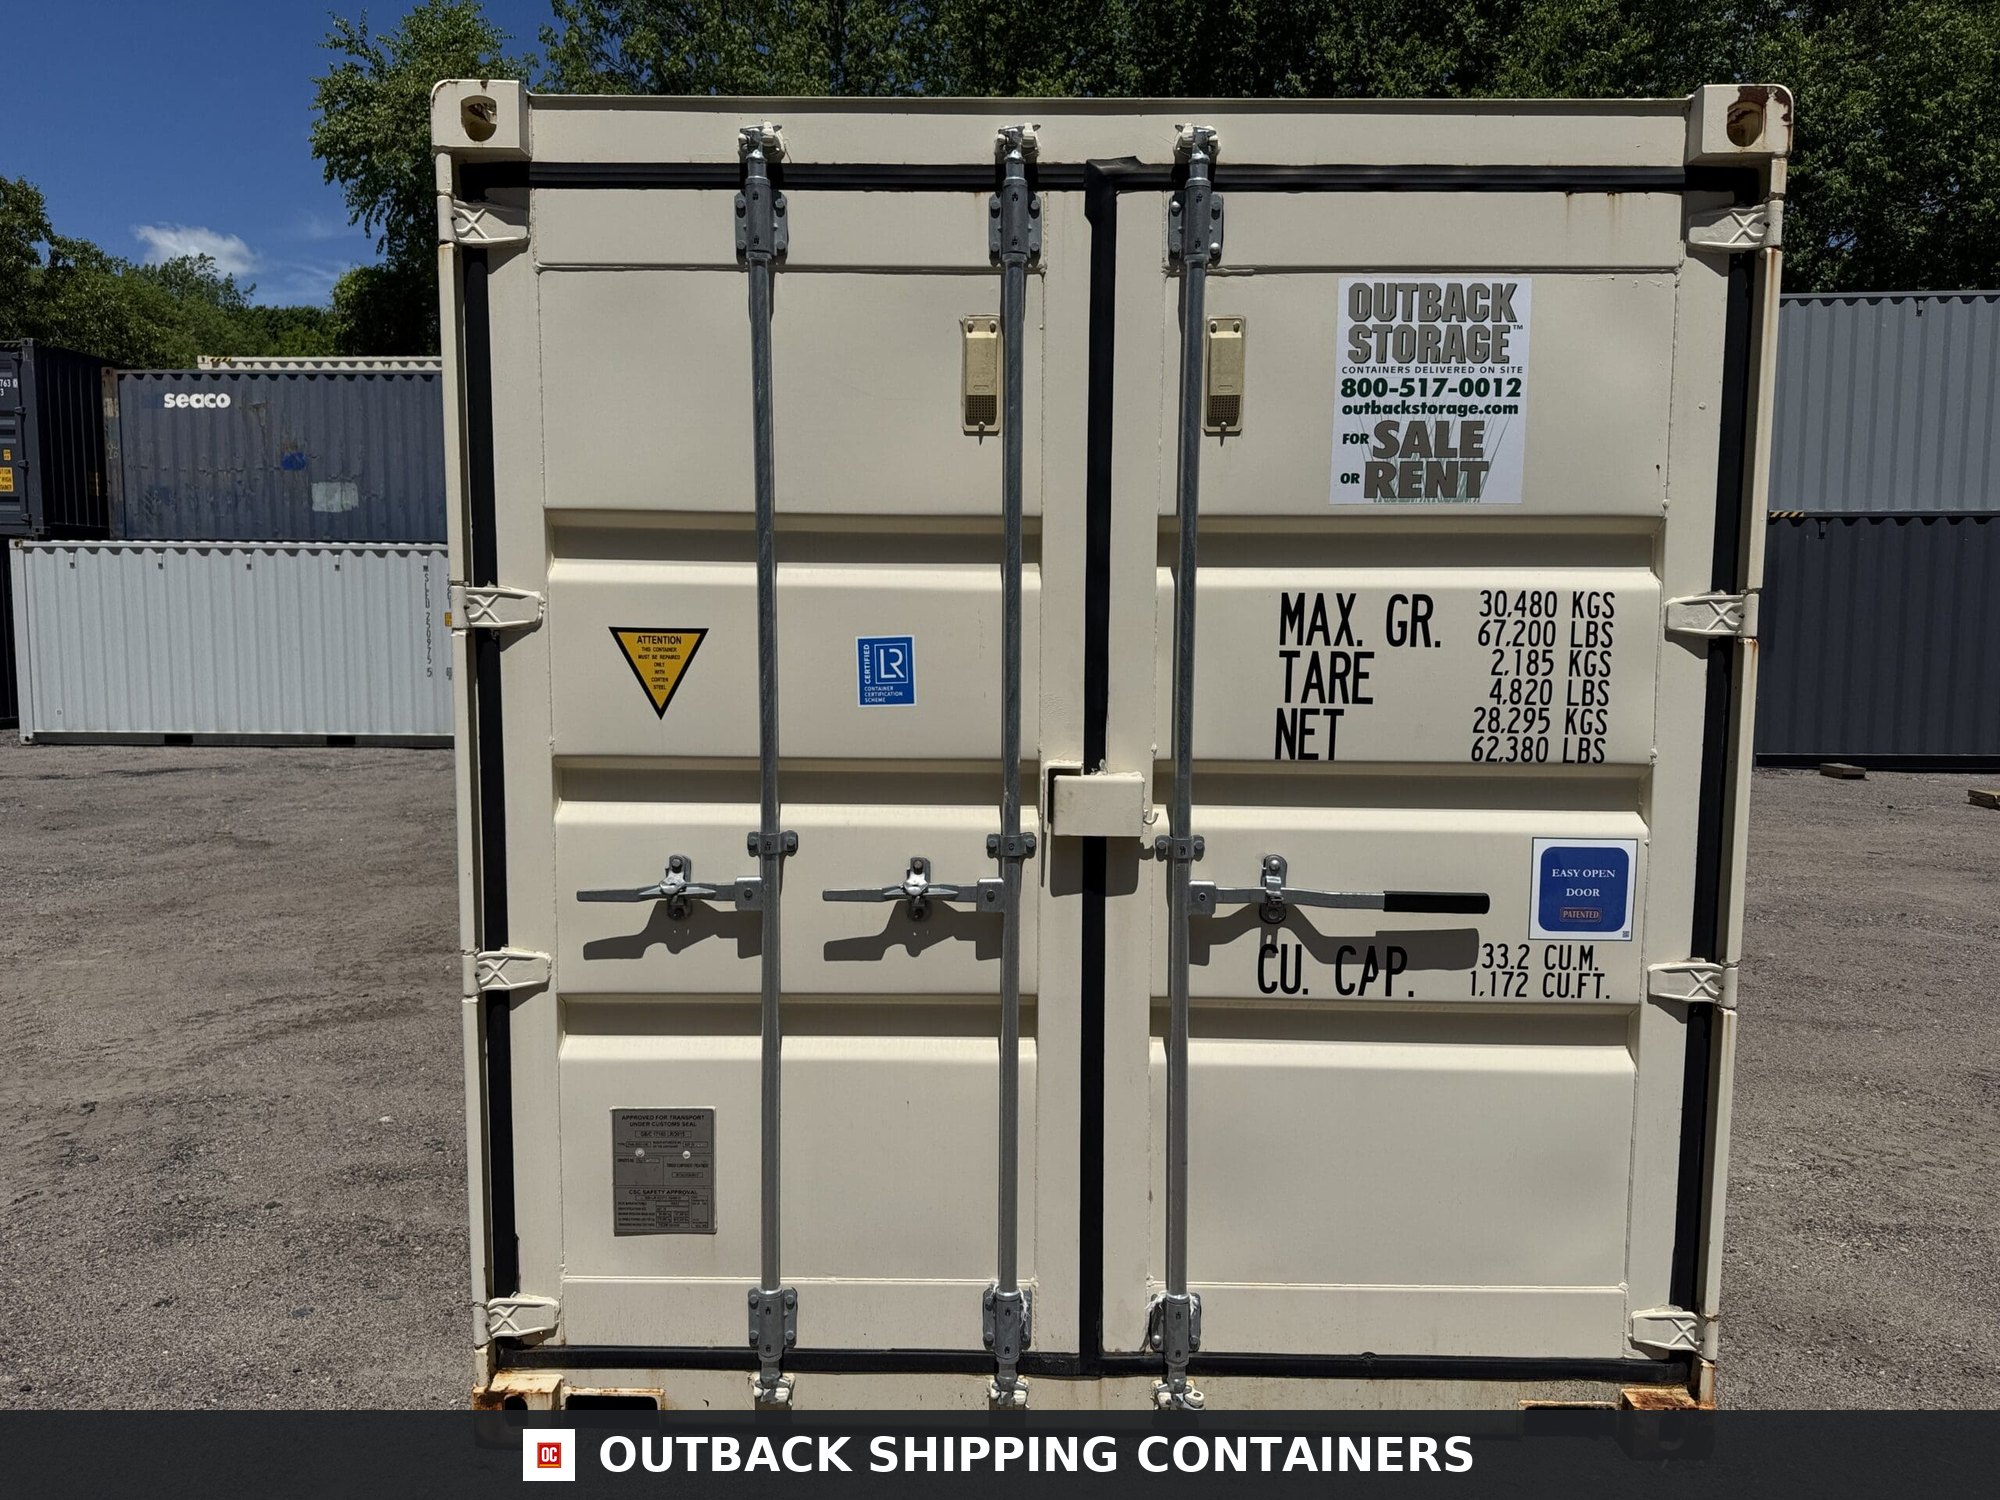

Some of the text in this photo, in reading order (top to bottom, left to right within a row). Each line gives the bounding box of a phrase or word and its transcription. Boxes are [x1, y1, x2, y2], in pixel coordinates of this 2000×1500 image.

[1347, 282, 1518, 323] OUTBACK
[1347, 324, 1512, 364] STORAGE
[1342, 366, 1523, 374] CONTAINERS DELIVERED ON SITE
[164, 392, 231, 409] seaco
[1341, 377, 1522, 398] 800-517-0012
[1342, 400, 1519, 418] outbackstorage.com
[1342, 419, 1486, 459] FOR SALE
[1340, 461, 1490, 499] OR RENT
[1280, 590, 1615, 648] MAX. GR. 30,480 KGS
[1478, 619, 1614, 648] 67,200 LBS
[636, 635, 682, 645] ATTENTION
[863, 644, 872, 684] CERTIFIED
[879, 648, 905, 679] LR
[1279, 649, 1612, 704] TARE 2,185 KGS
[1489, 678, 1610, 706] 4,820 LBS
[1275, 707, 1608, 760] NET 28,295 KGS
[1471, 736, 1606, 763] 62,380 LBS
[1552, 868, 1615, 878] EASY OPEN
[1566, 888, 1600, 897] DOOR
[1563, 910, 1599, 919] PATENTED
[1258, 943, 1599, 997] CU. CAP. 33.2 CU.M.
[1470, 970, 1610, 999] 1,172 CU.FT.
